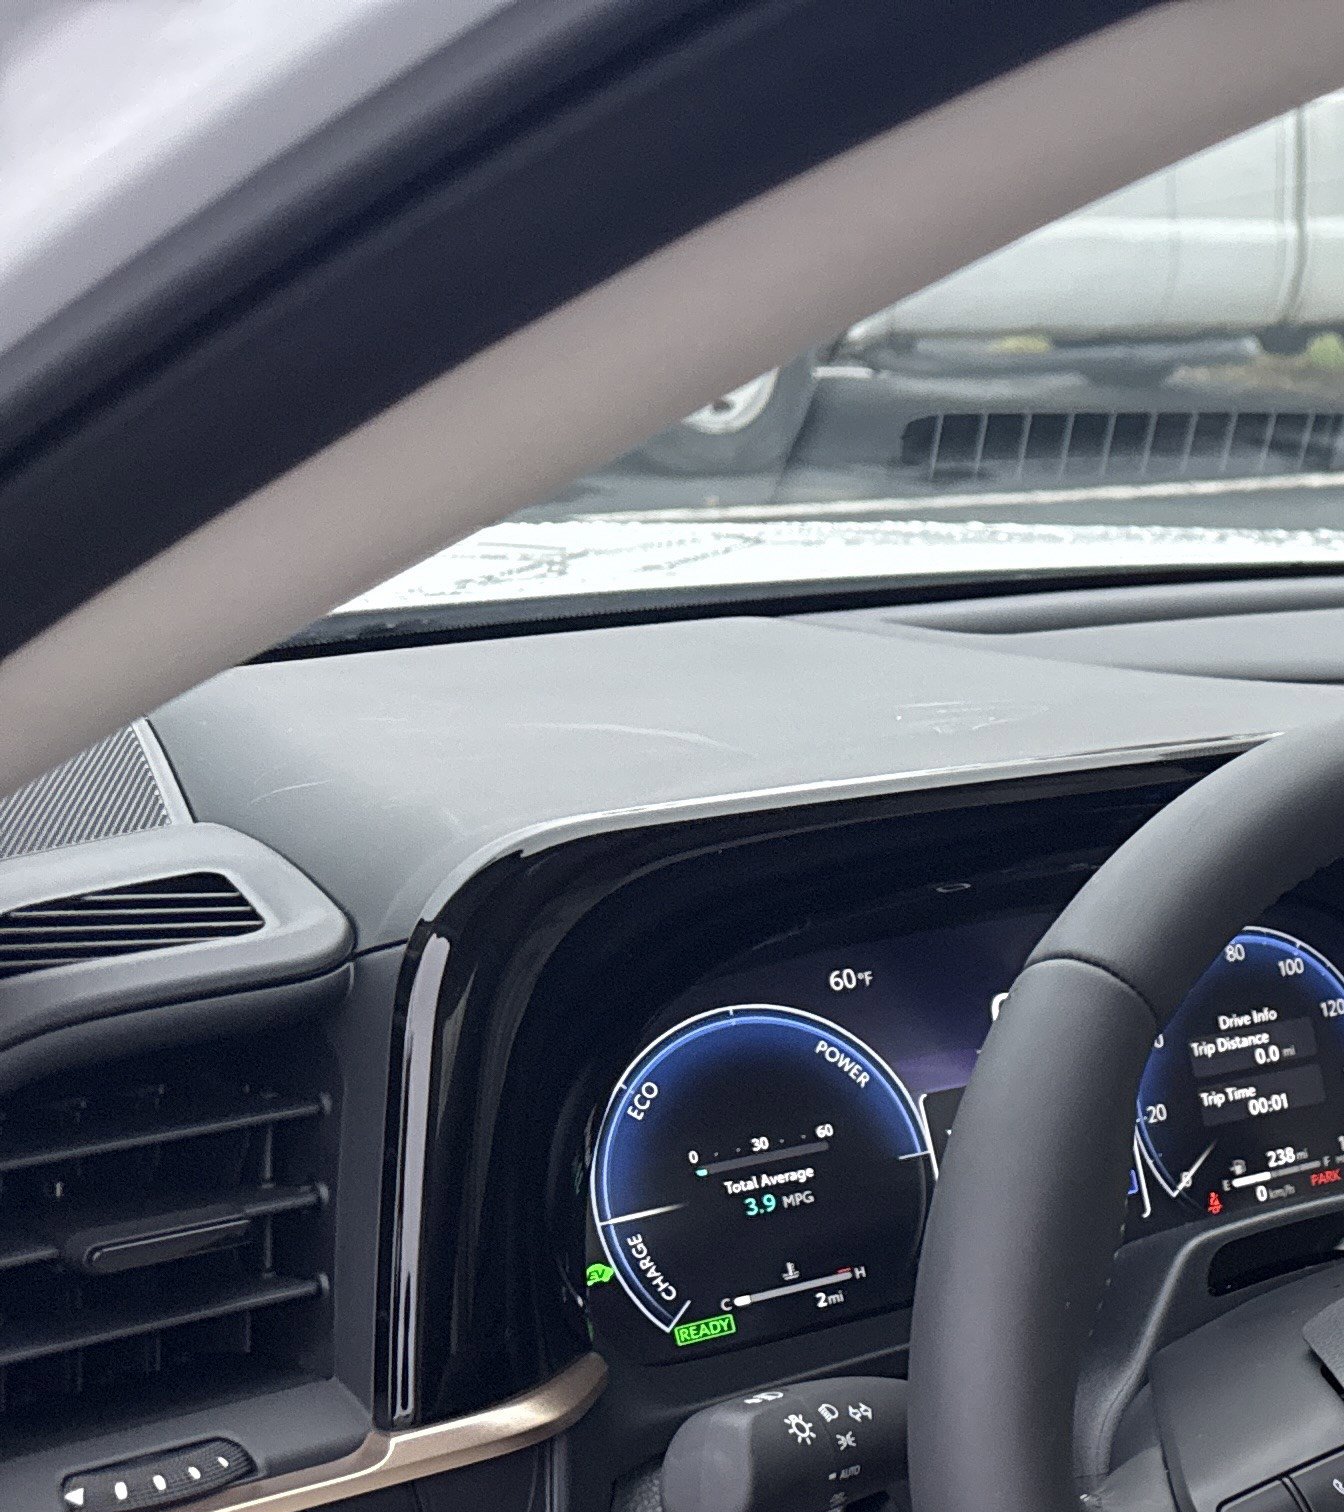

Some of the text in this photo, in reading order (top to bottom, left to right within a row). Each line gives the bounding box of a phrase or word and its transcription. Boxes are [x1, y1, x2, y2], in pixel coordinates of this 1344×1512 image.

[1226, 944, 1245, 962] 80
[1278, 958, 1304, 976] 100
[1218, 1008, 1278, 1030] Drive Info
[1191, 1032, 1270, 1058] Trip Distance
[814, 1040, 870, 1088] POWER
[1254, 1046, 1296, 1064] 0.0 mi
[627, 1080, 658, 1122] ECO
[1200, 1084, 1256, 1108] Trip Time
[1248, 1094, 1288, 1116] 00:01
[1146, 1104, 1167, 1122] 20
[816, 1123, 834, 1138] 60
[751, 1136, 769, 1151] 30
[688, 1150, 698, 1165] 0
[1322, 1156, 1330, 1166] F
[724, 1166, 814, 1195] Total Average
[1222, 1180, 1230, 1192] E
[1310, 1168, 1342, 1186] PARK
[1256, 1185, 1268, 1202] 0
[744, 1191, 815, 1217] 3.9 MPG
[627, 1233, 678, 1301] CHARGE
[854, 1266, 867, 1280] H
[720, 1298, 732, 1312] C
[677, 1317, 732, 1343] READY
[840, 1464, 861, 1480] AUTO
